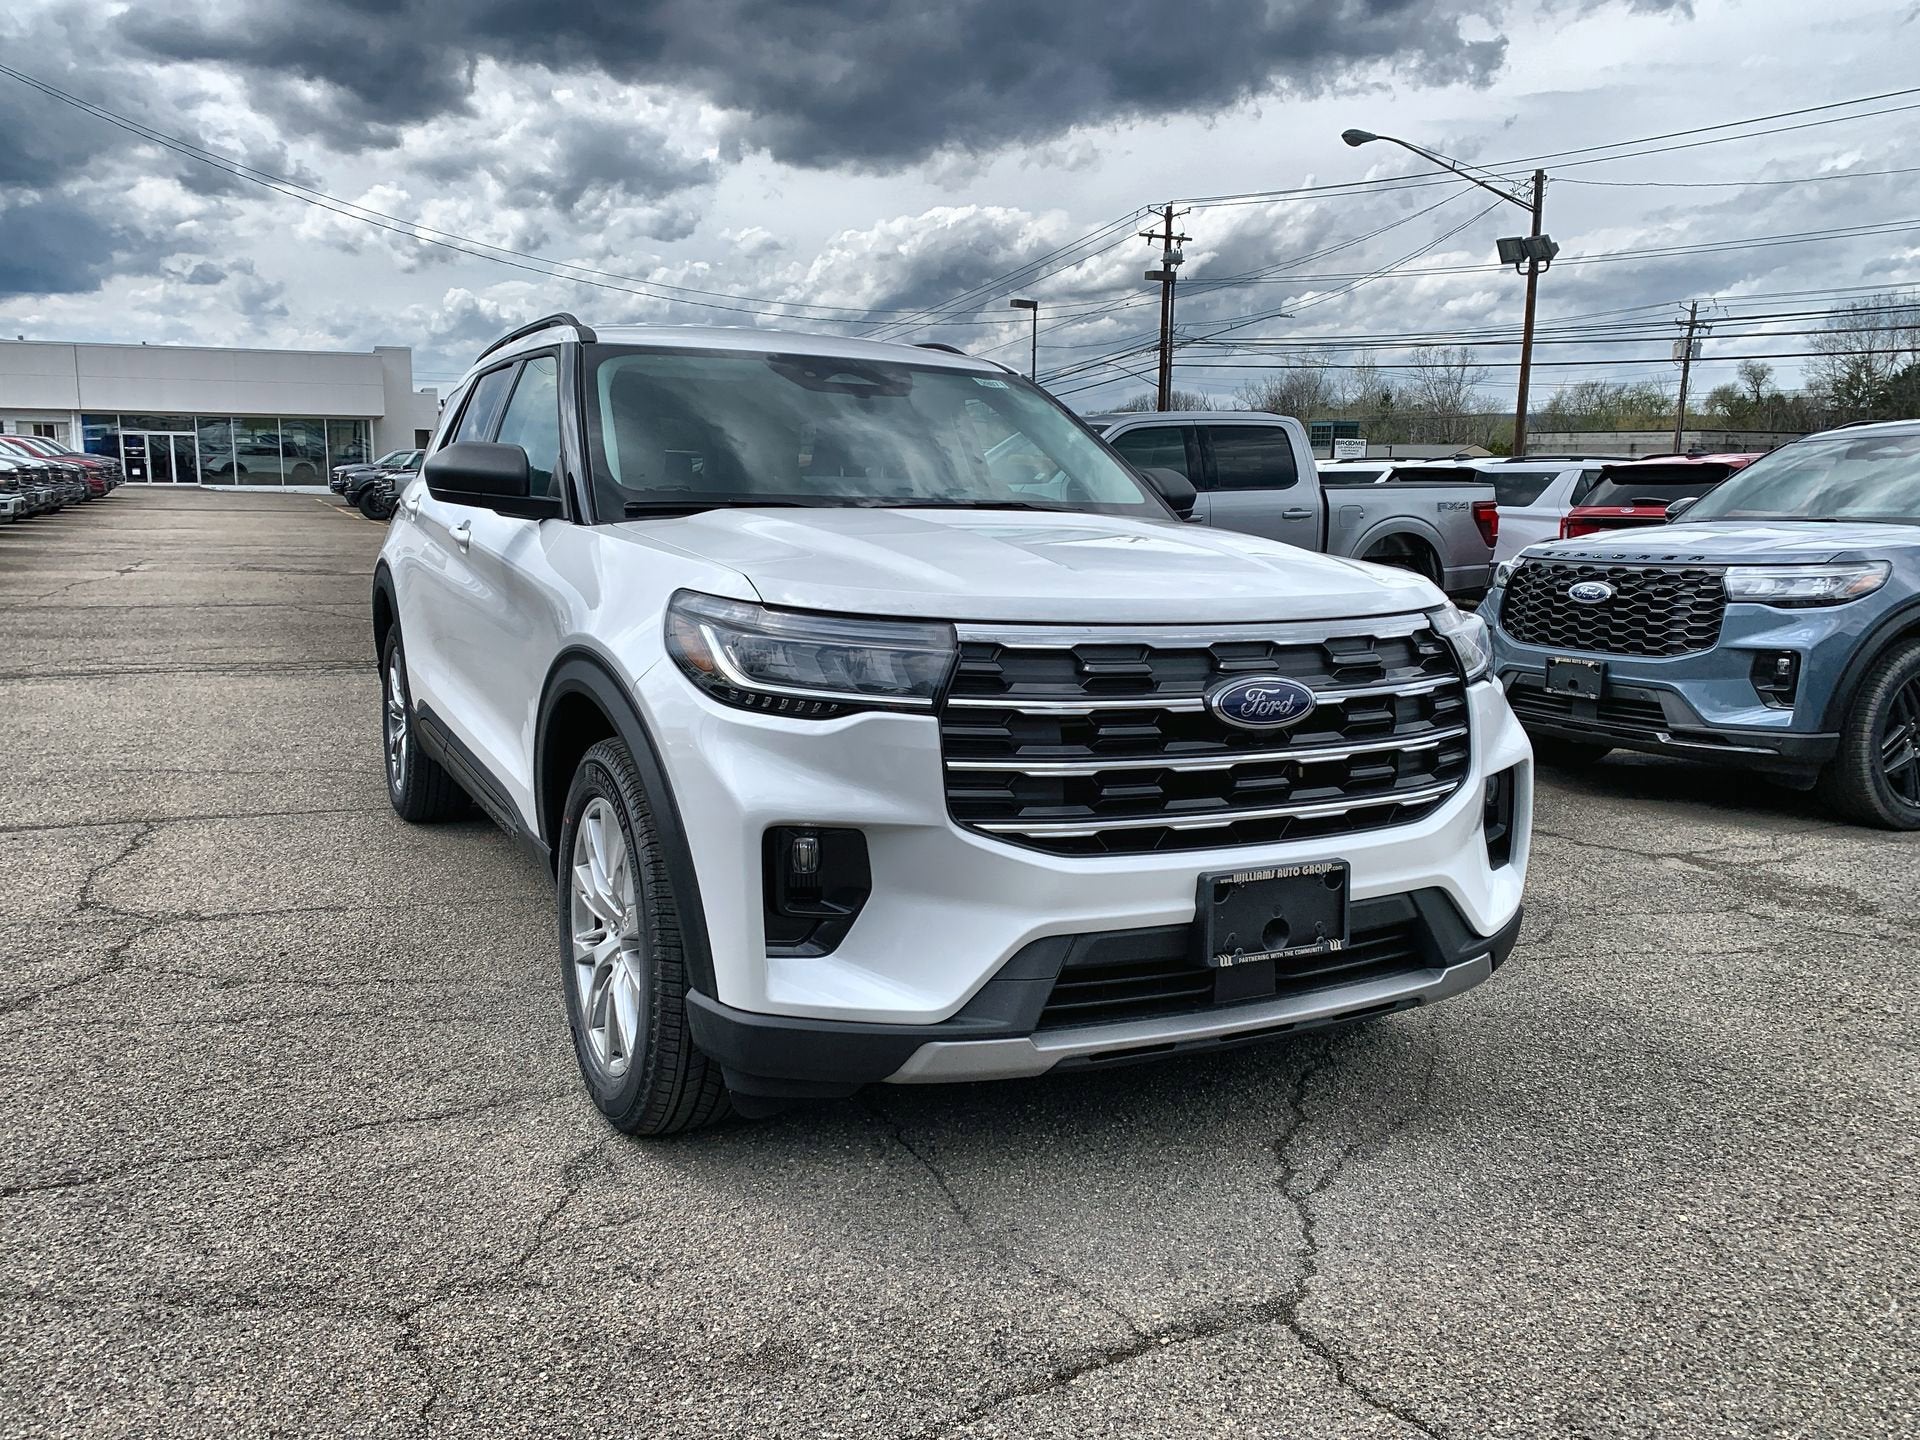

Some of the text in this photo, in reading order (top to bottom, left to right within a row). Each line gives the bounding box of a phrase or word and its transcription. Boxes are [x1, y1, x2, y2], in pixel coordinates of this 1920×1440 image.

[1437, 501, 1470, 512] FX4
[1241, 688, 1295, 717] Ford
[1277, 866, 1300, 878] AUTO
[1238, 953, 1270, 964] PARTNERING
[1270, 951, 1284, 960] WITH
[1284, 949, 1294, 957] THE
[1295, 946, 1324, 956] COMMUNITY
